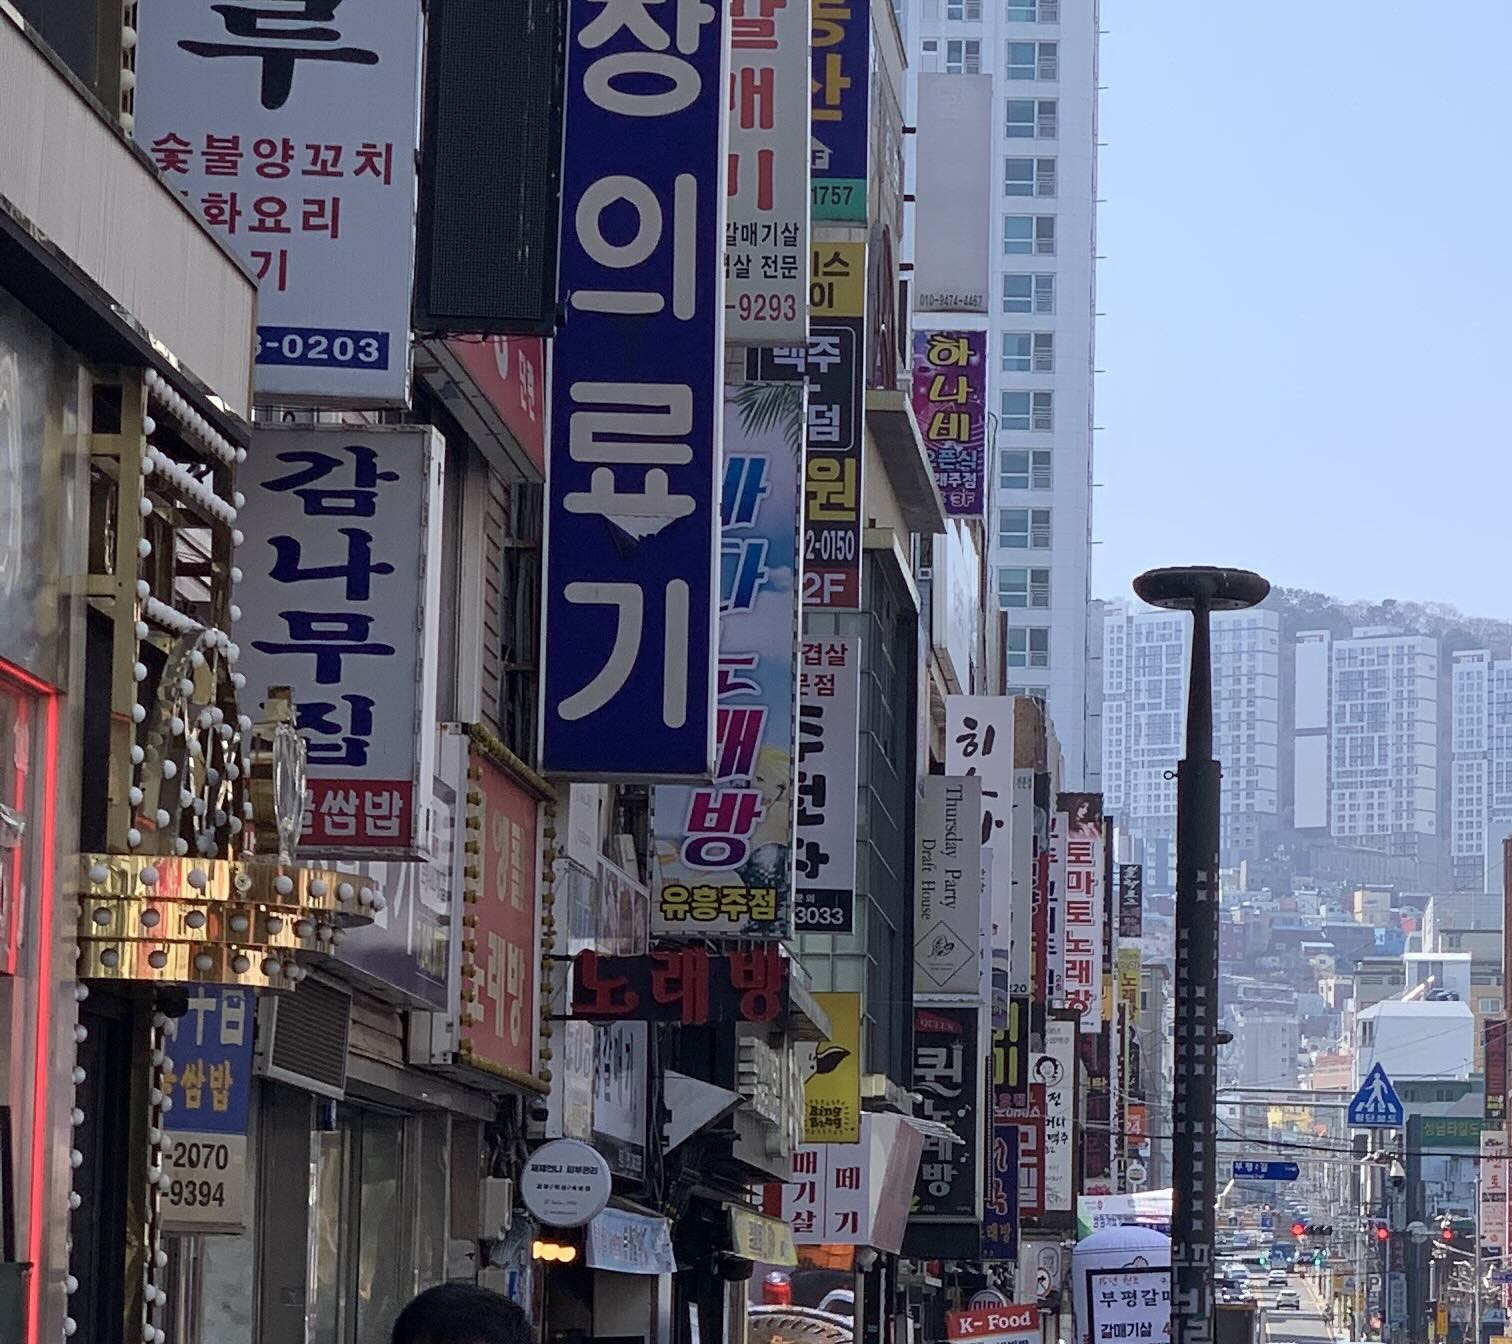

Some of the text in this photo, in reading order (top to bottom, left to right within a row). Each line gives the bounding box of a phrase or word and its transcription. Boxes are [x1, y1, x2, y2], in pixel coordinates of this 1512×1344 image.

[150, 131, 395, 186] 숯불양꼬치
[180, 190, 342, 240] 화요리
[761, 254, 798, 280] 전문
[927, 334, 976, 443] 하나비
[250, 444, 401, 768] 감나무집
[803, 572, 847, 605] 2F
[659, 885, 778, 922] 유흥주점
[921, 838, 938, 921] Draft House
[570, 946, 788, 1025] 노래방
[988, 1310, 1032, 1332] Food
[1100, 1321, 1153, 1339] 갈매기살
